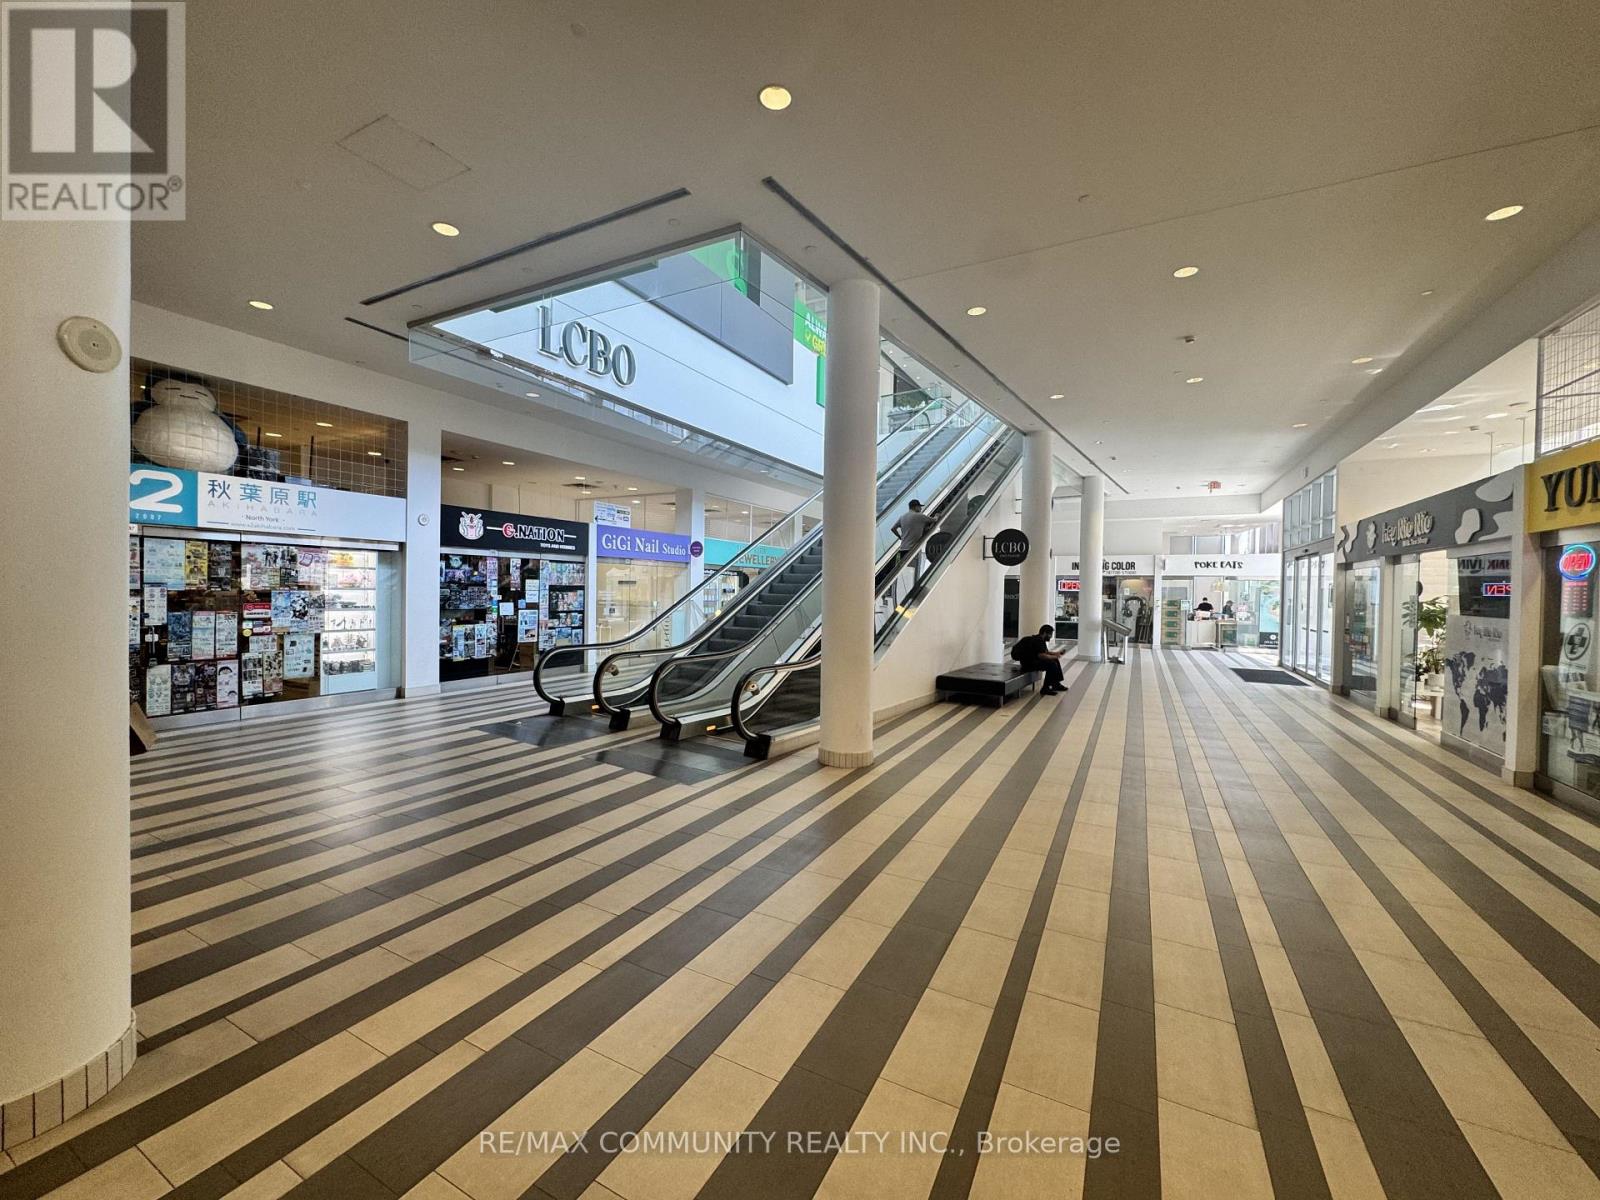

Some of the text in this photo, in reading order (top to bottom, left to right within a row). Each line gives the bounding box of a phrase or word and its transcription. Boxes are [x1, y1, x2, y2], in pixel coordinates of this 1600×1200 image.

[537, 304, 637, 387] LCBO
[207, 479, 317, 509] 秋葉原駅
[265, 515, 279, 523] York
[601, 533, 631, 551] GiGi
[635, 537, 659, 554] Nail
[662, 543, 686, 556] Studio
[994, 541, 1026, 554] LCBO
[1111, 562, 1136, 571] COLOR
[1194, 561, 1244, 569] POKE EATS
[1563, 553, 1592, 572] OPEN
